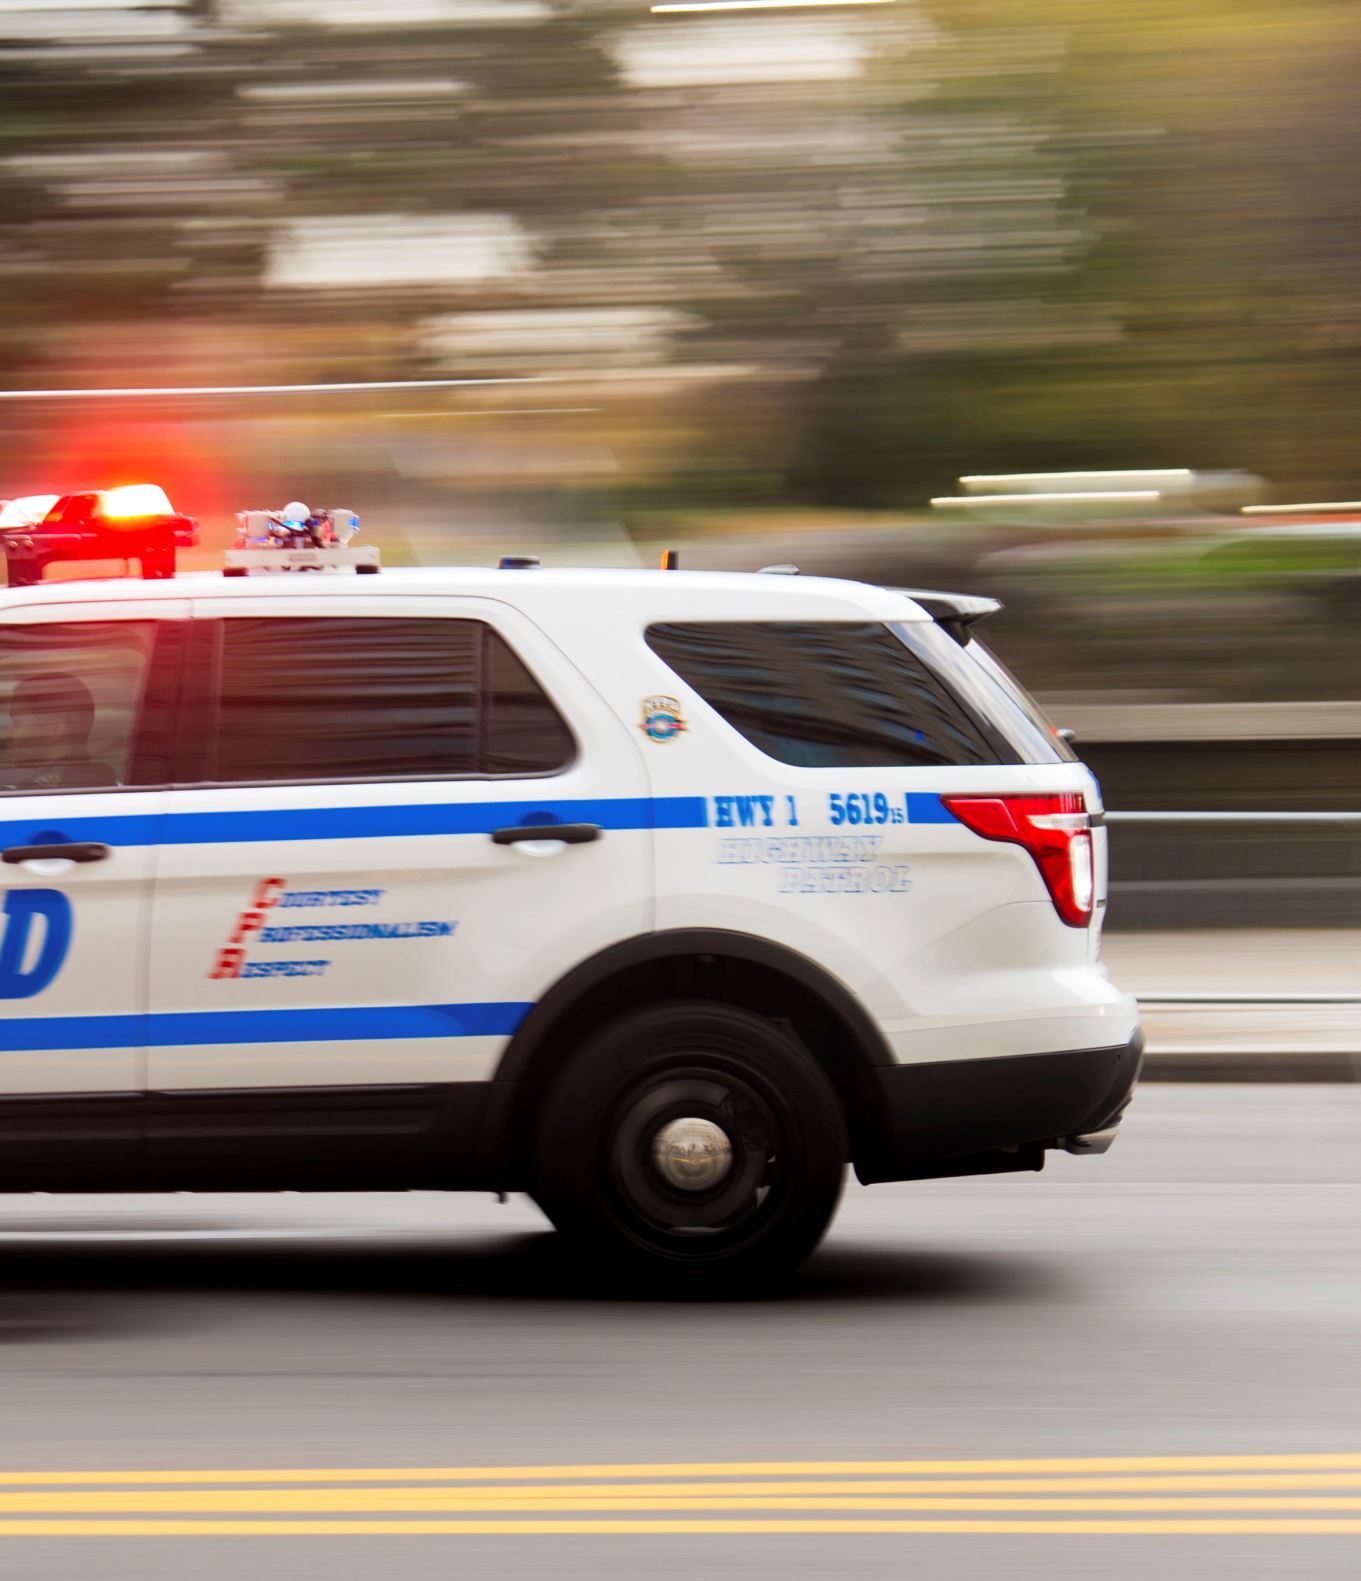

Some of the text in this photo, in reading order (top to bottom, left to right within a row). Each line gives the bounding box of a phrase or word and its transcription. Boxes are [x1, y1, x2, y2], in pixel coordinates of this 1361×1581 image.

[713, 794, 774, 827] HWY
[785, 794, 799, 827] 1
[829, 792, 889, 826] 5619
[715, 835, 885, 864] HIGHWAY
[249, 877, 387, 909] COURTESY
[778, 865, 913, 893] PATROL
[224, 911, 460, 944] PROFESSIONALISM
[204, 947, 333, 980] RESPECT
